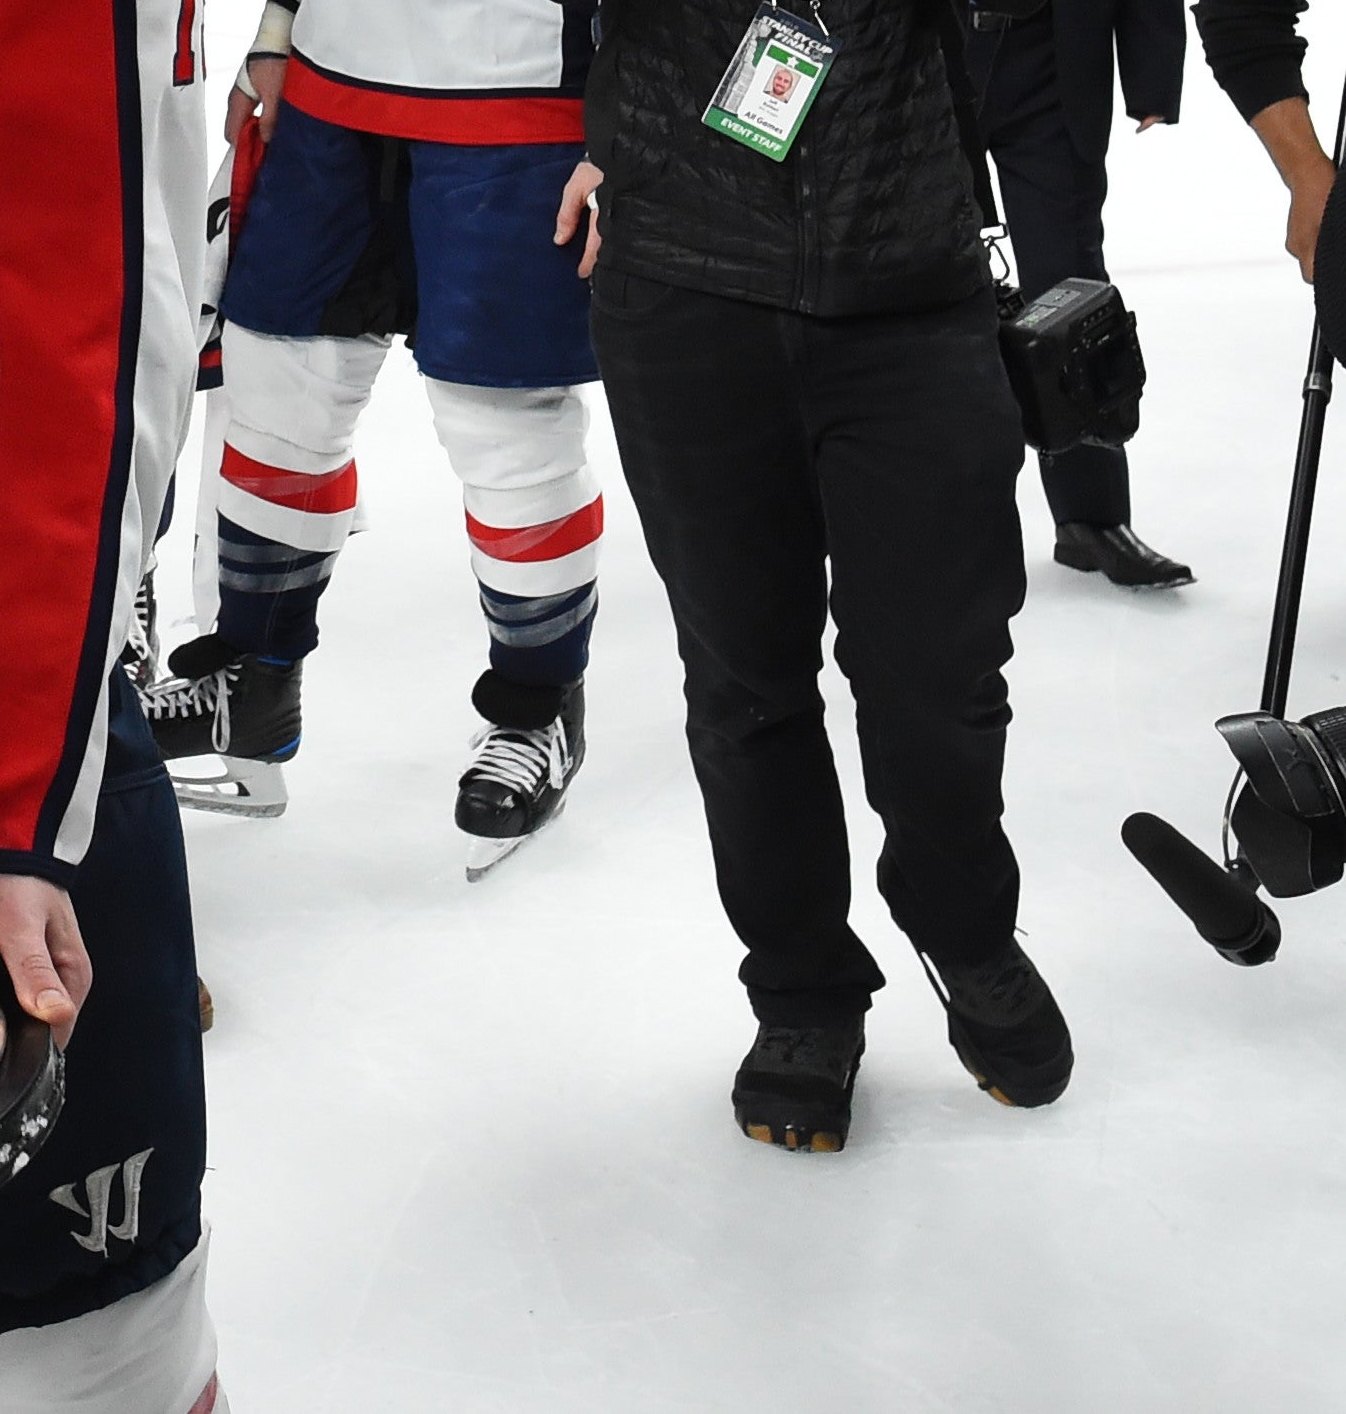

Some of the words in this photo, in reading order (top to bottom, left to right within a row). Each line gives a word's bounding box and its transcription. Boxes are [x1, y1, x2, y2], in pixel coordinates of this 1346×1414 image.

[762, 16, 811, 43] STANLEY
[808, 39, 834, 54] CUP
[774, 32, 812, 55] FINAL
[720, 117, 754, 138] EVENT
[752, 134, 783, 152] STAFF
